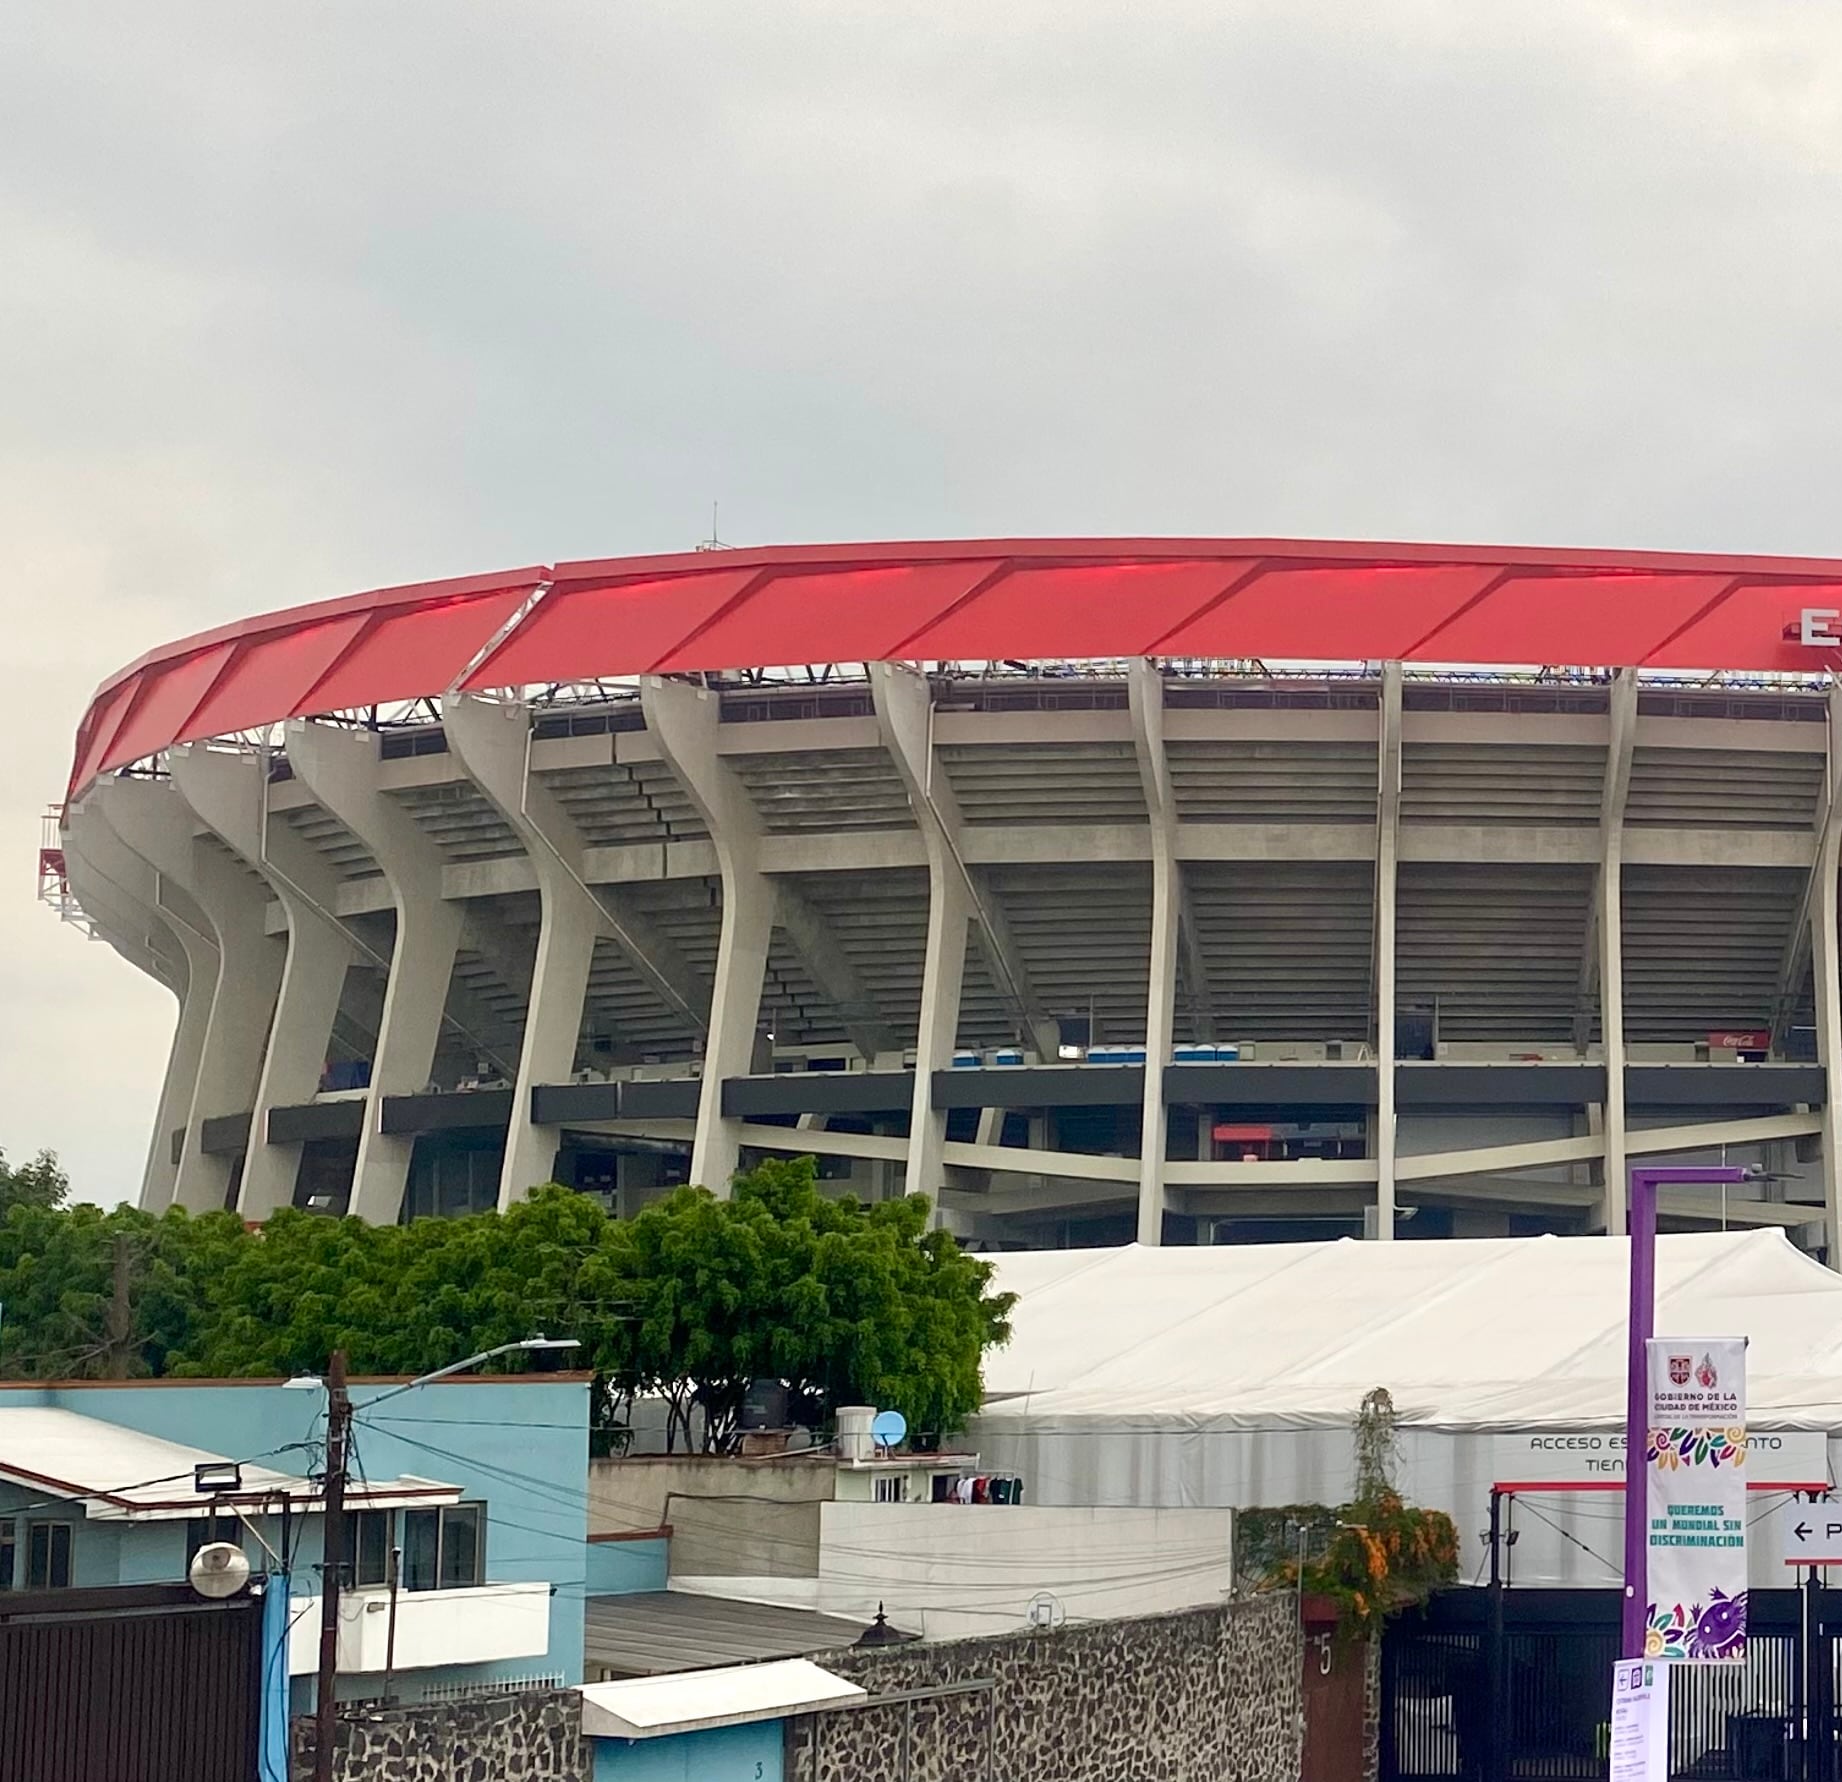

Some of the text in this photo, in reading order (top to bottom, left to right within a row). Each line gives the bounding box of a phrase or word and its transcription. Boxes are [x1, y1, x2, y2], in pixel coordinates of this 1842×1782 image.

[1654, 1402, 1738, 1411] CIUDAD DE MÉXICO
[1530, 1437, 1601, 1449] ACCESO
[1667, 1505, 1724, 1516] QUEREMOS
[1652, 1519, 1742, 1531] UN MUNDIAL SIN
[1650, 1534, 1744, 1547] DISCRIMINACIÓN
[1320, 1632, 1331, 1675] 5
[755, 1761, 763, 1780] 3
